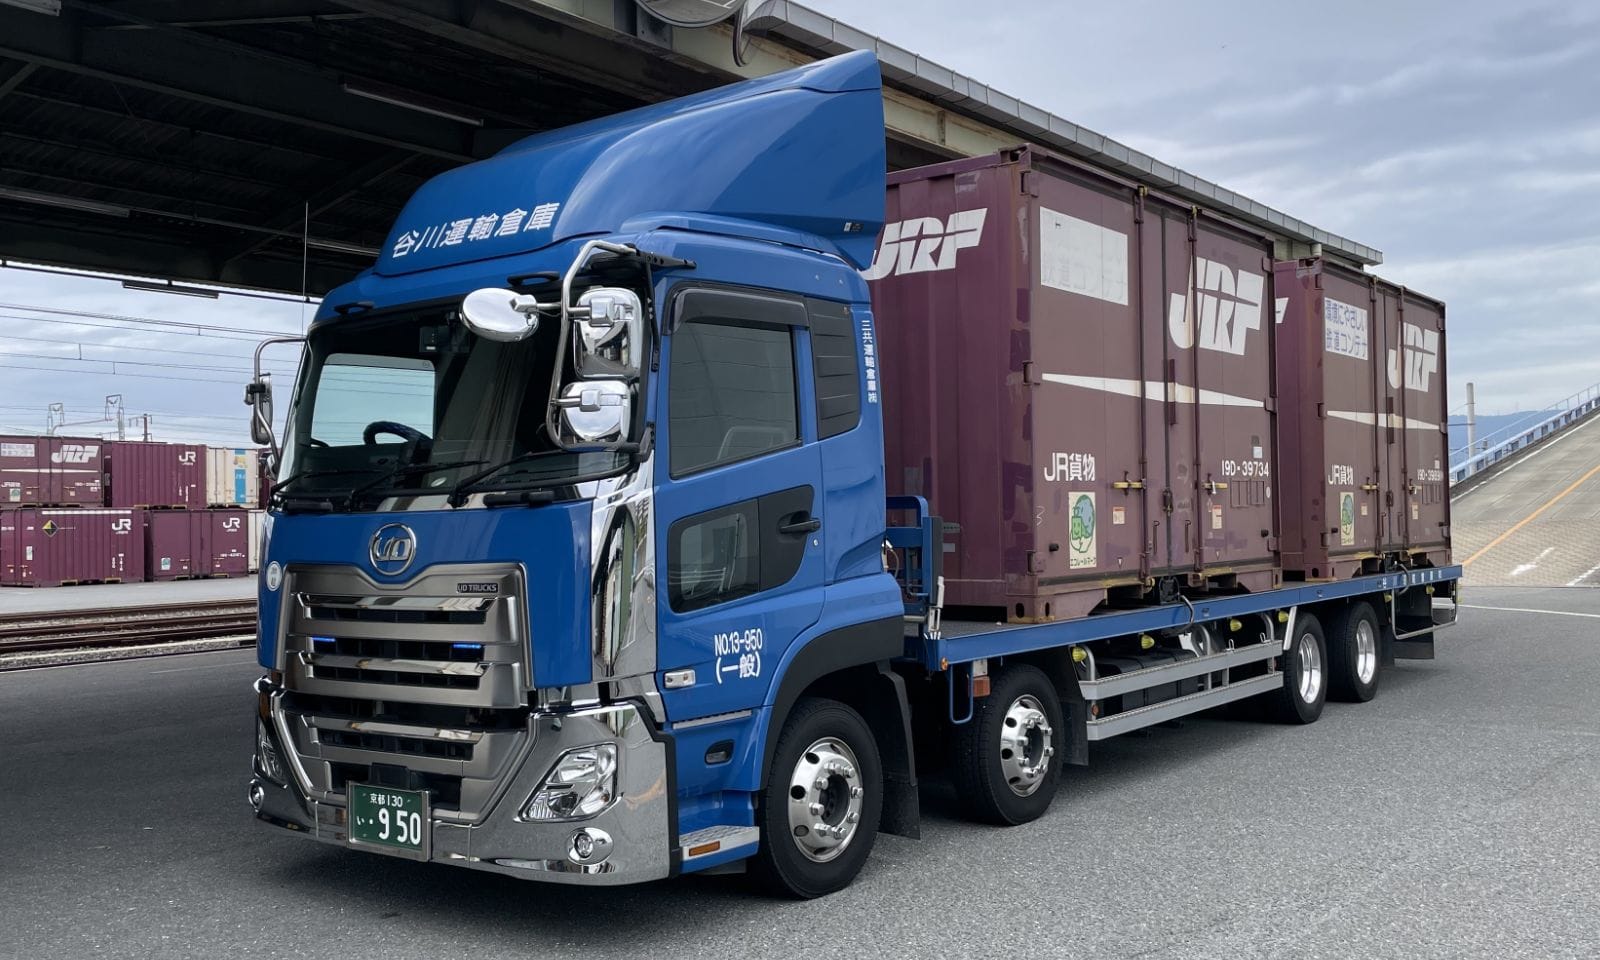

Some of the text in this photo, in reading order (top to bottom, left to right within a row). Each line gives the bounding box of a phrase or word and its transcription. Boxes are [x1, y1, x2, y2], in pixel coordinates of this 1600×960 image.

[392, 202, 560, 258] 谷川運輸倉庫
[857, 208, 987, 280] JRF
[1169, 256, 1264, 355] JRF
[1388, 320, 1439, 392] JRF
[51, 445, 99, 463] JRF
[178, 451, 196, 462] JR
[1044, 453, 1096, 481] JR貨物
[112, 519, 132, 530] JR
[223, 517, 241, 528] JR
[714, 629, 762, 656] NO.13-950
[716, 651, 760, 684] (一般)
